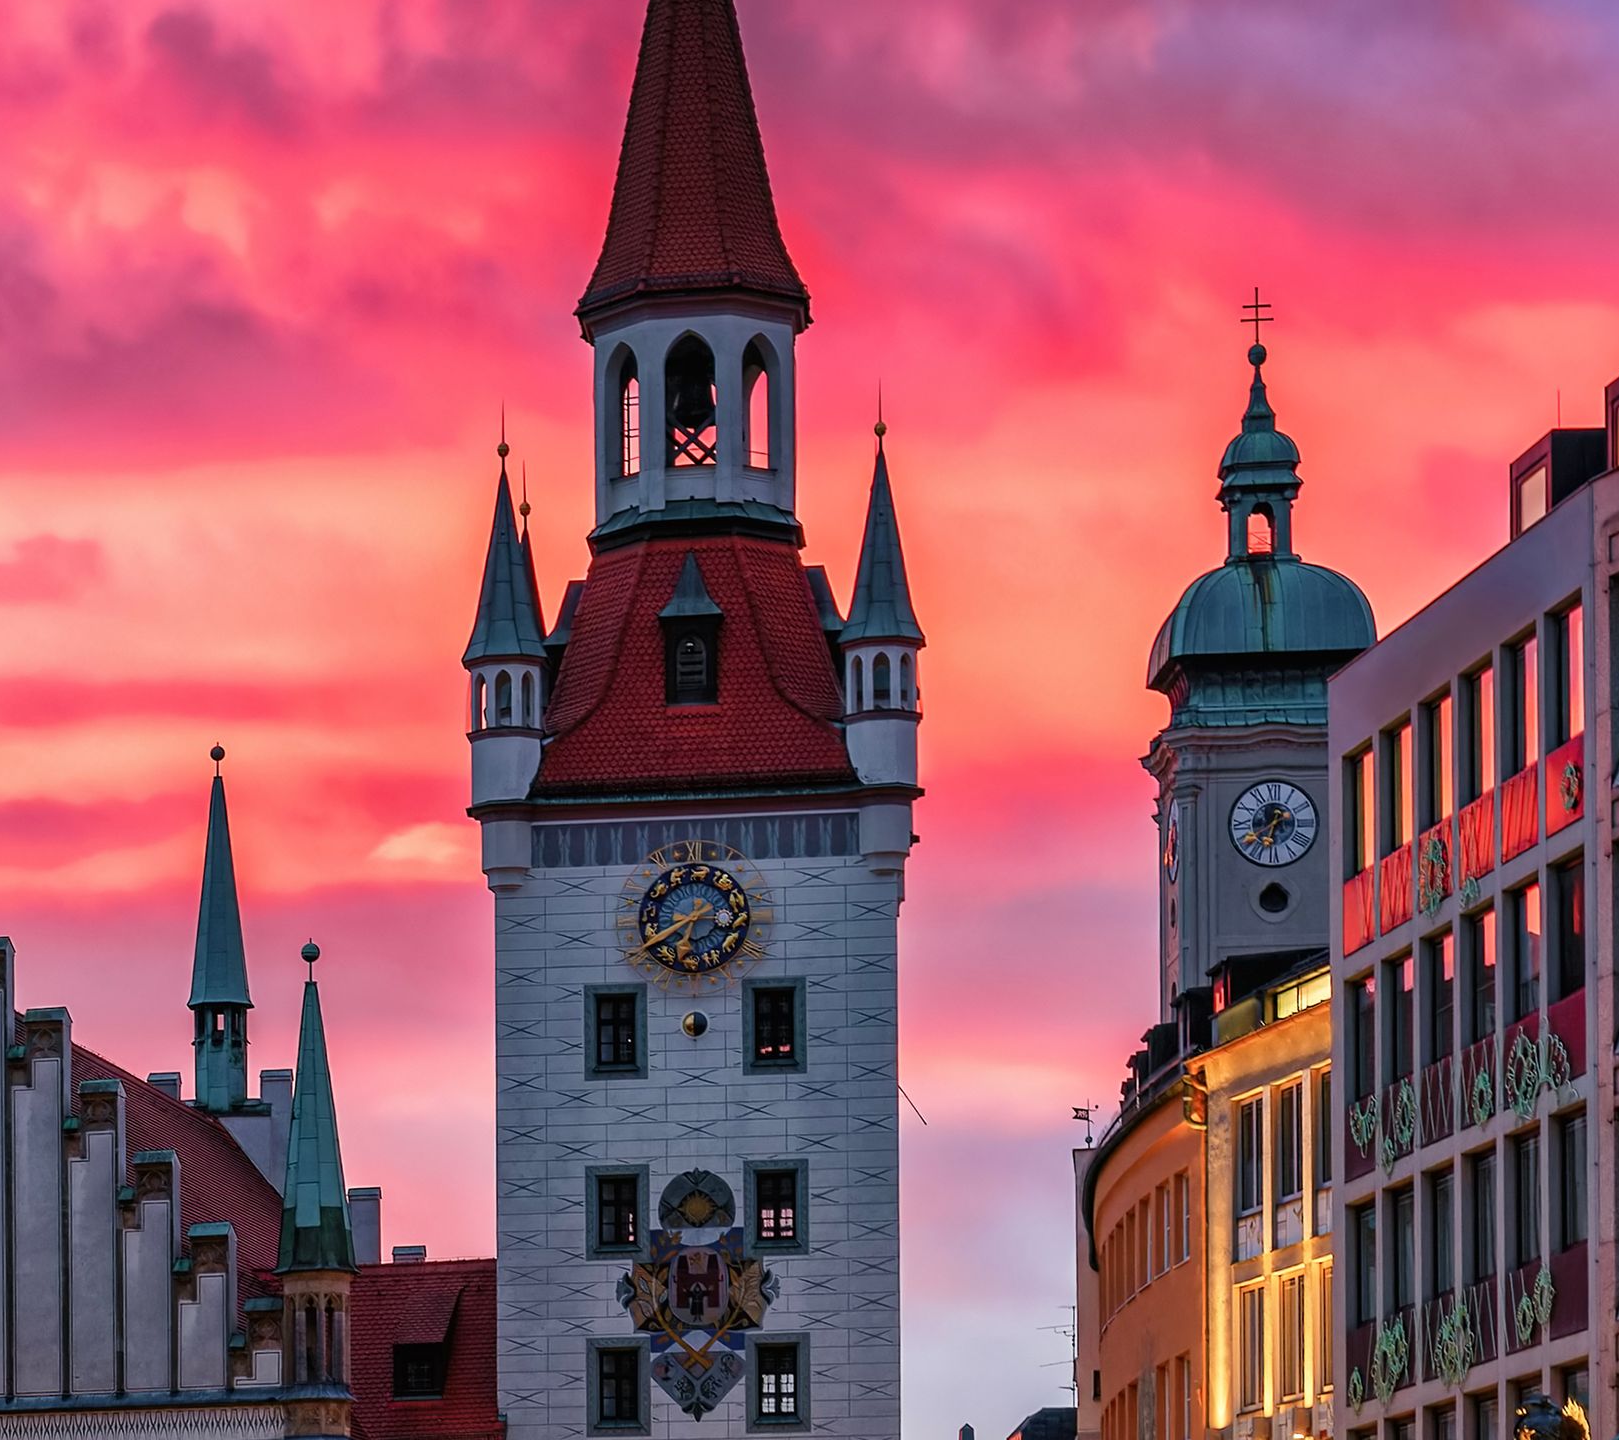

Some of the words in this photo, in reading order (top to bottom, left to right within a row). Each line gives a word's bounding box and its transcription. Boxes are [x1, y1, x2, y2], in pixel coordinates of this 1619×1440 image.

[1250, 788, 1266, 807] XI
[1267, 784, 1281, 801] XII
[1284, 788, 1295, 805] I
[1237, 802, 1255, 816] X
[1293, 800, 1310, 814] II
[1233, 819, 1251, 830] IX
[685, 841, 702, 862] XII
